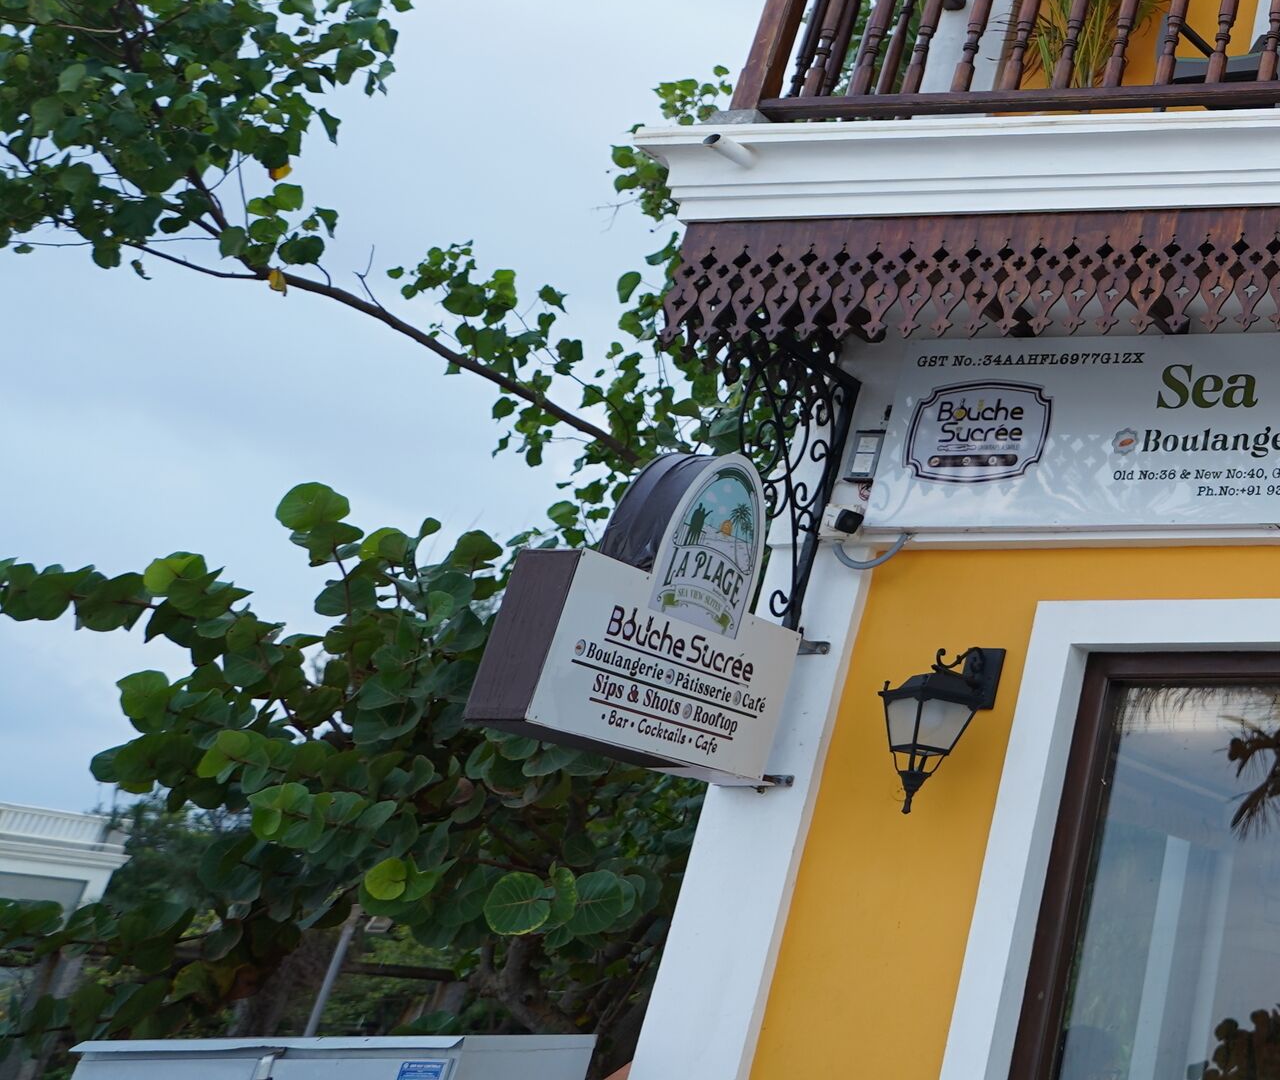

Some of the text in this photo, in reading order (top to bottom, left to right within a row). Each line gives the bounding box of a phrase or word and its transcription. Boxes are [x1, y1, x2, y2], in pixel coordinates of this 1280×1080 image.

[917, 356, 948, 367] GST
[1156, 363, 1258, 410] Sea
[937, 398, 1024, 421] Bouche
[938, 422, 1023, 442] Sucrée
[1113, 470, 1134, 480] Old
[1138, 470, 1176, 480] No:36
[1180, 470, 1191, 480] &
[1194, 469, 1222, 480] New
[1225, 468, 1268, 481] No:40,
[1197, 485, 1262, 497] Ph.No:+91
[663, 546, 743, 609] LA PLAGE
[606, 604, 754, 682] Bouche Sucrée
[586, 642, 766, 713] Boulangerie Pâtisserie Café
[592, 673, 738, 736] Sips & Shots Rooftop
[608, 710, 718, 755] Bar Cocktails Cafe
